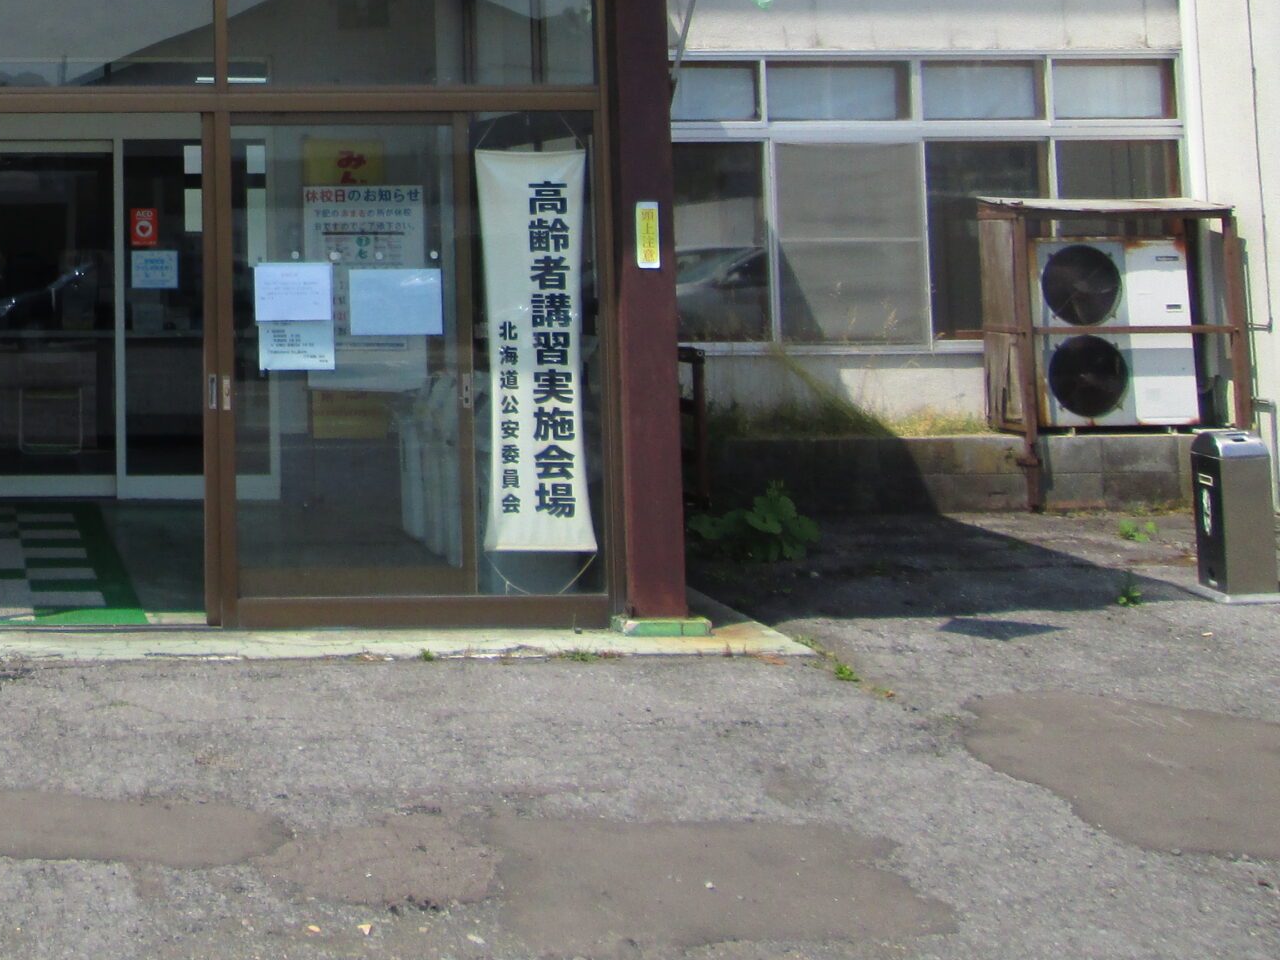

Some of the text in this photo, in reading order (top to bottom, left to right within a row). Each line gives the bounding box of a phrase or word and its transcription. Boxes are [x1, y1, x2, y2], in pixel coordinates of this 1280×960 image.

[135, 210, 153, 218] AED
[306, 189, 420, 203] 休校日のお知らせ
[528, 181, 576, 518] 高齢者講習実施会場
[499, 321, 521, 514] 北海道公安委員会
